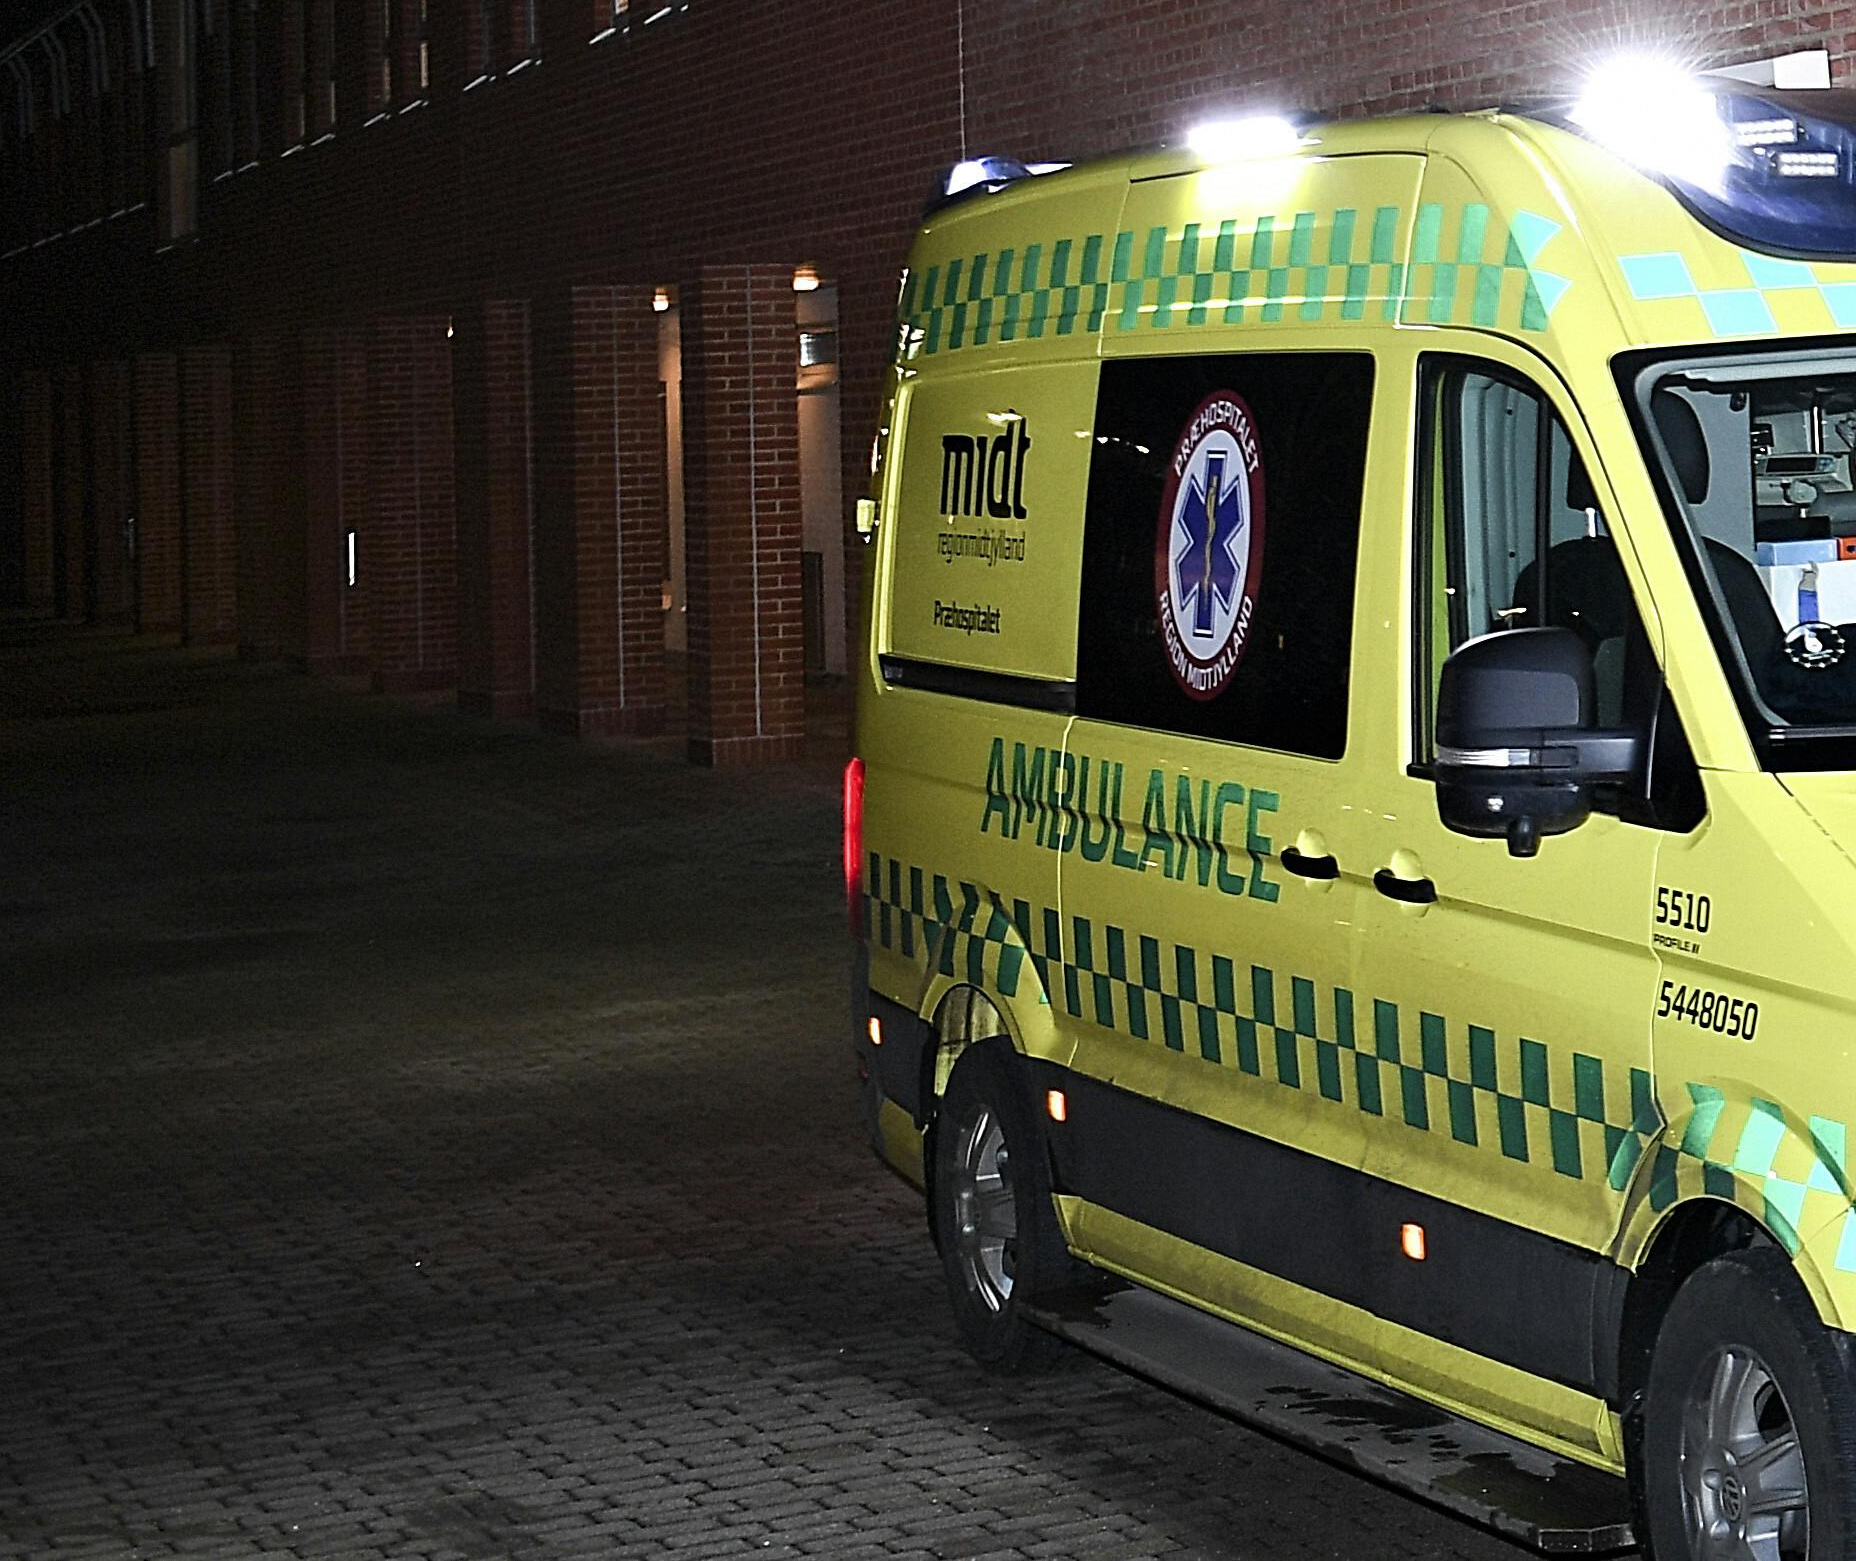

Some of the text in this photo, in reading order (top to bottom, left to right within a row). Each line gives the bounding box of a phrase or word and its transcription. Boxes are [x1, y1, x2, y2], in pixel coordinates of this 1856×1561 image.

[1174, 400, 1259, 477] PRÆHOSPITALET
[1160, 590, 1253, 691] REGION MIDTJYLLAND
[980, 737, 1280, 903] AMBULANCE
[1653, 933, 1690, 952] PROFILE
[1656, 886, 1711, 933] 5510
[1657, 980, 1759, 1041] 5448050
